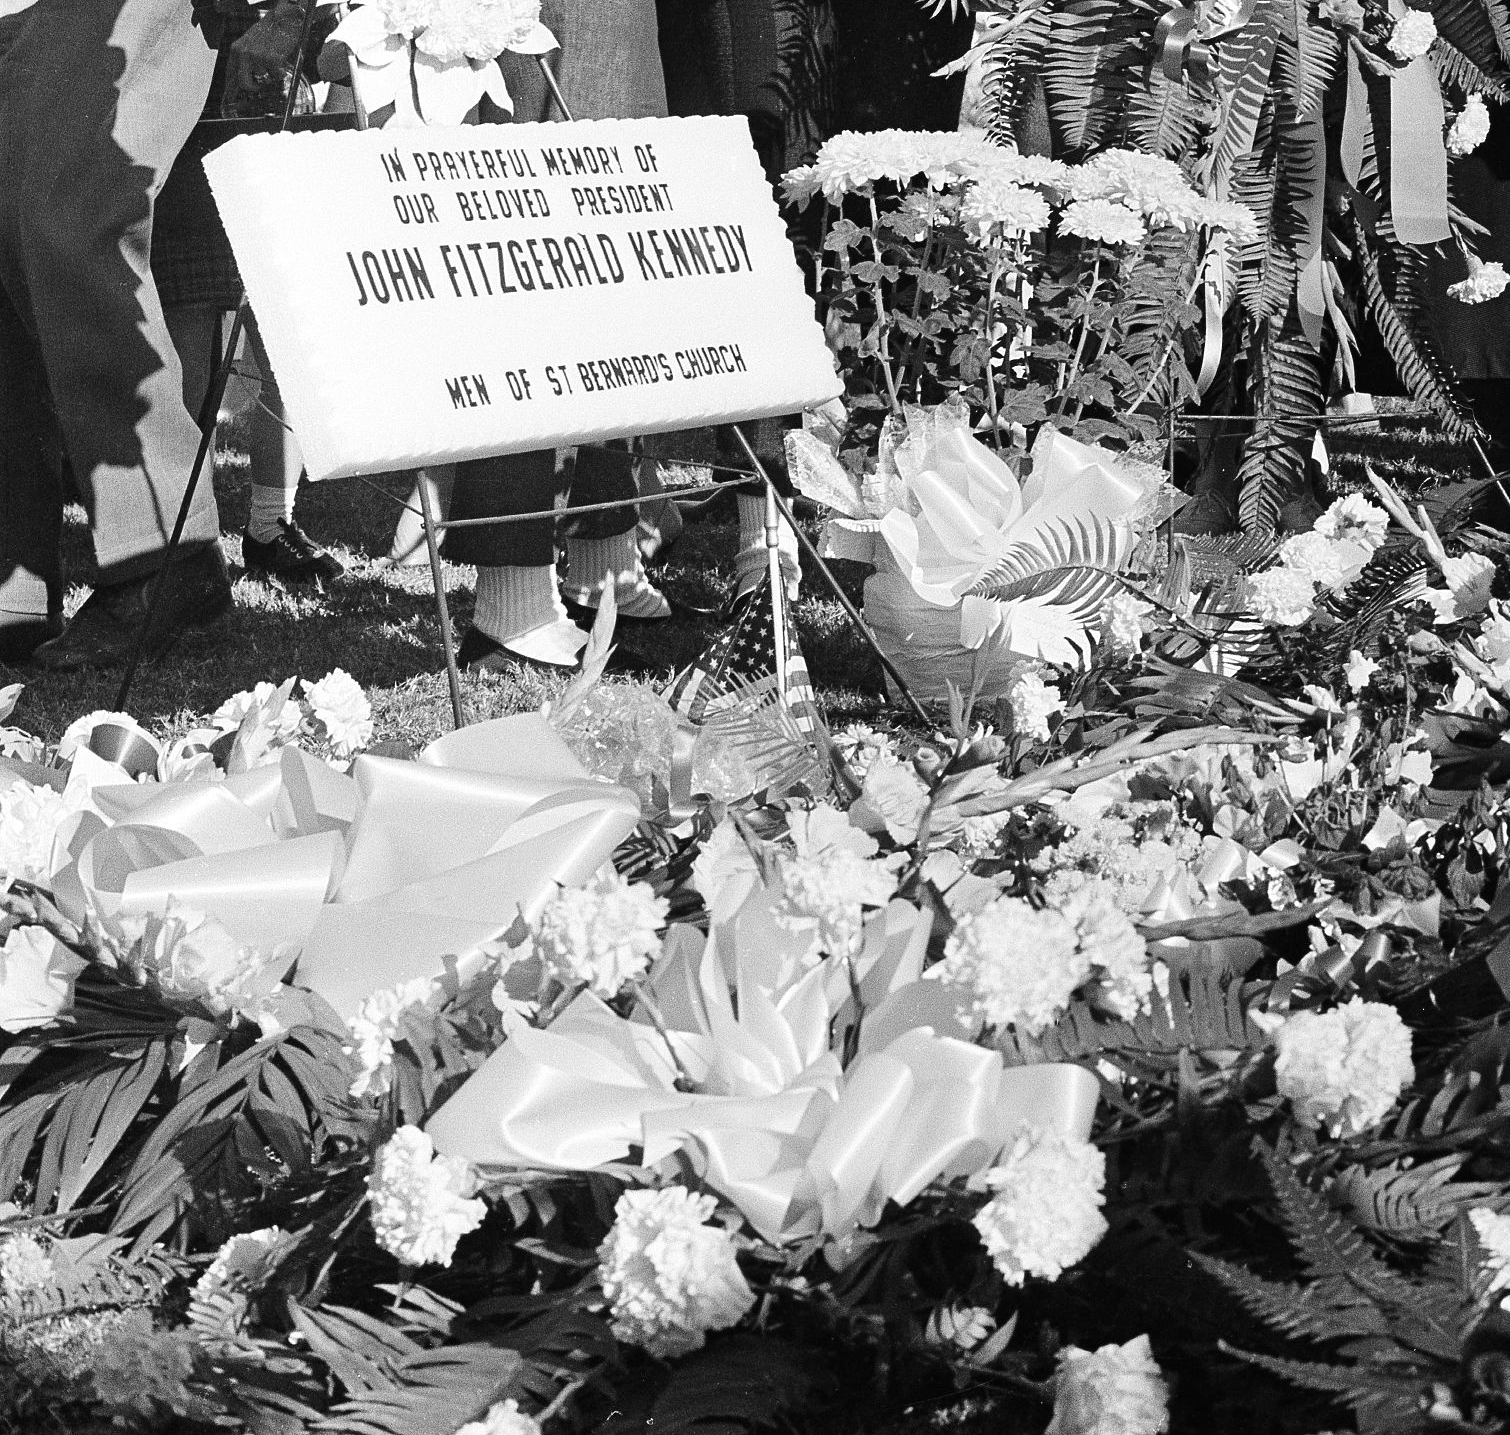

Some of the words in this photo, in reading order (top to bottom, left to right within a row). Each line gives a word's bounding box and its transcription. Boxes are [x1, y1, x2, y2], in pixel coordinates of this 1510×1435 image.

[380, 150, 407, 183] IN
[412, 149, 538, 182] PRAYERFUL
[540, 146, 624, 177] MEMORY
[634, 144, 660, 173] OF
[392, 194, 440, 225] OUR
[456, 188, 552, 222] BELOVED
[571, 183, 675, 217] PRESIDENT
[346, 247, 435, 307] JOHN
[439, 232, 626, 298] FITZGERALD
[628, 224, 754, 281] KENNEDY
[445, 374, 491, 410] MEN
[505, 368, 532, 402] OF
[544, 365, 574, 397] ST
[576, 352, 675, 393] BERNARD'S
[675, 344, 749, 380] CHURCH
